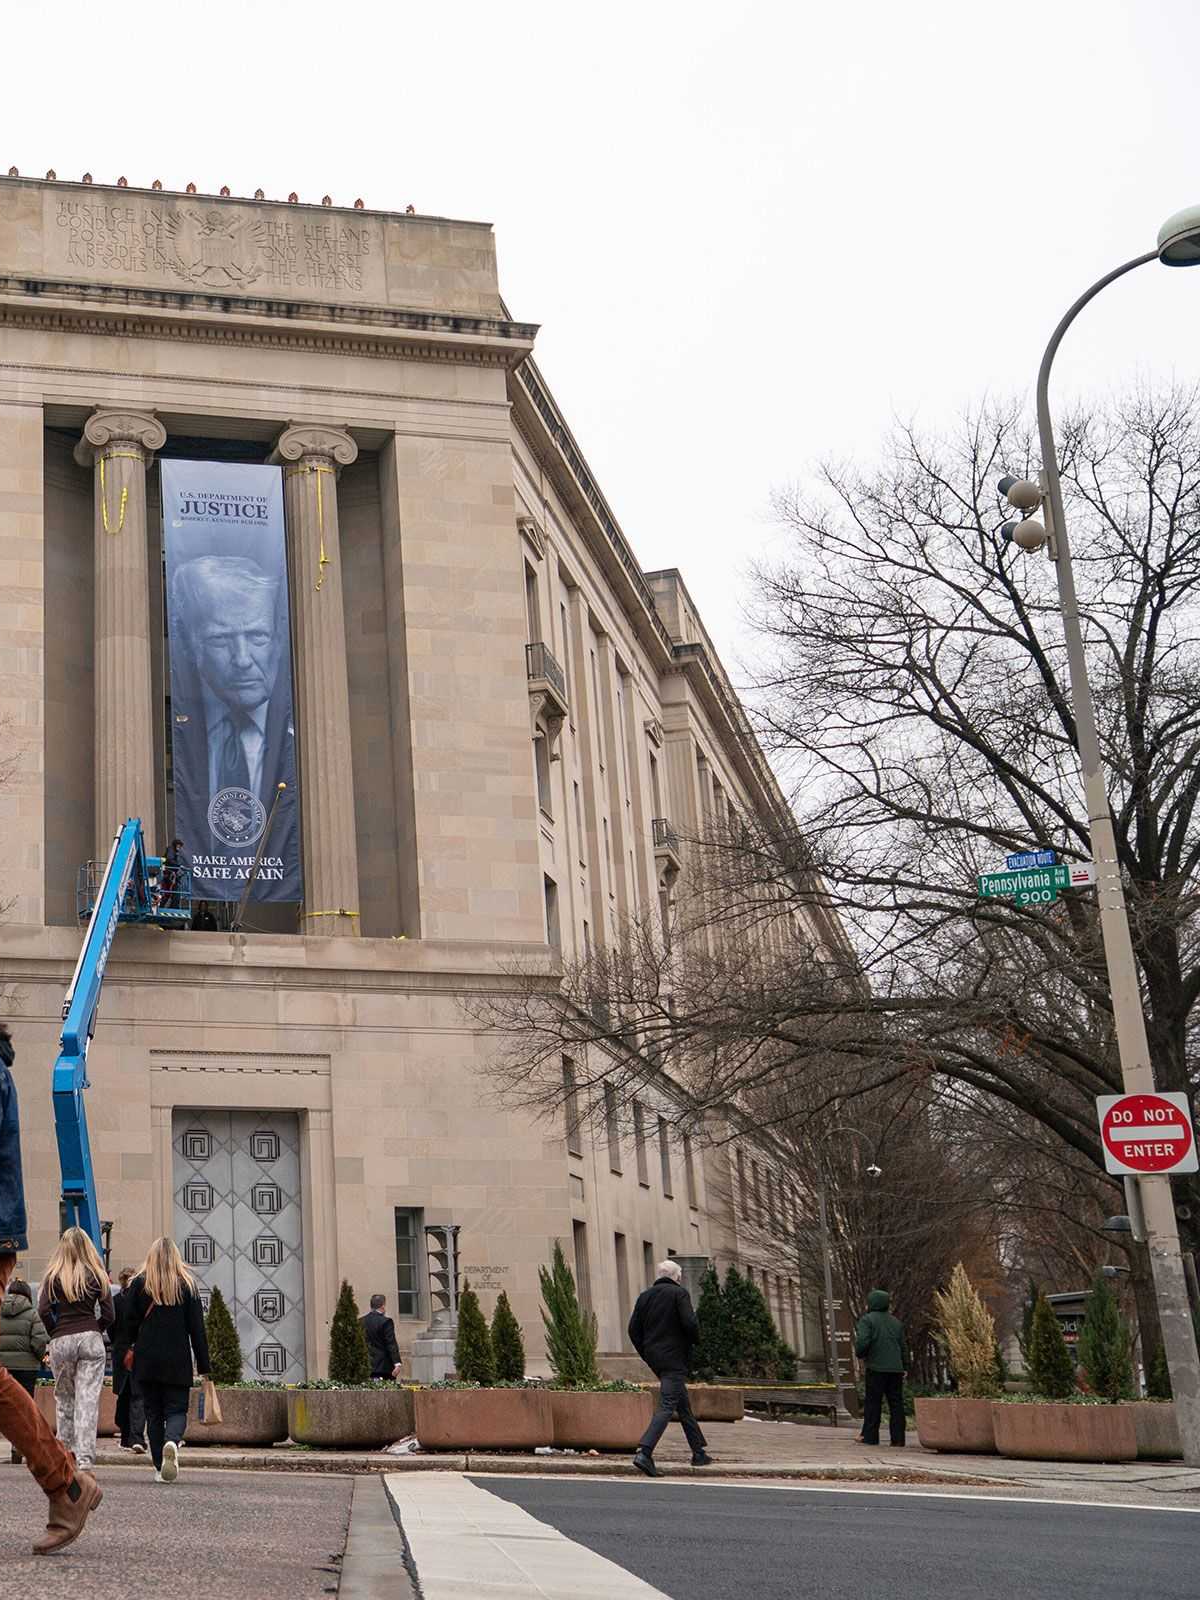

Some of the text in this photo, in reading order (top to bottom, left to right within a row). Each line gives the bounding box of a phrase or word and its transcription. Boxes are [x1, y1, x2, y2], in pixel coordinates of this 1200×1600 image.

[59, 202, 370, 242] JUSTICE IN THE LIFE AND
[57, 214, 370, 255] CONDUCT OF THE STATE IS
[70, 228, 362, 267] POSSIBLE ONLY AS FIRST
[87, 242, 146, 260] RESIDES
[152, 248, 167, 261] IN
[267, 259, 297, 274] THE
[307, 262, 362, 278] HEARTS
[67, 251, 96, 268] AND
[102, 257, 148, 273] SOULS
[264, 272, 293, 286] THE
[295, 274, 362, 291] CITIZENS
[180, 491, 194, 499] U.S.
[197, 493, 254, 503] DEPARTMENT
[180, 500, 268, 519] JUSTICE
[192, 855, 284, 867] MAKE AMERICA
[192, 866, 231, 879] SAFE
[982, 868, 1065, 893] Pennsylvania Ave
[1055, 876, 1066, 885] NW
[1020, 890, 1051, 904] 900
[1112, 1108, 1175, 1123] DO NOT
[1123, 1143, 1175, 1158] ENTER
[464, 1265, 510, 1274] DEPARTMENT
